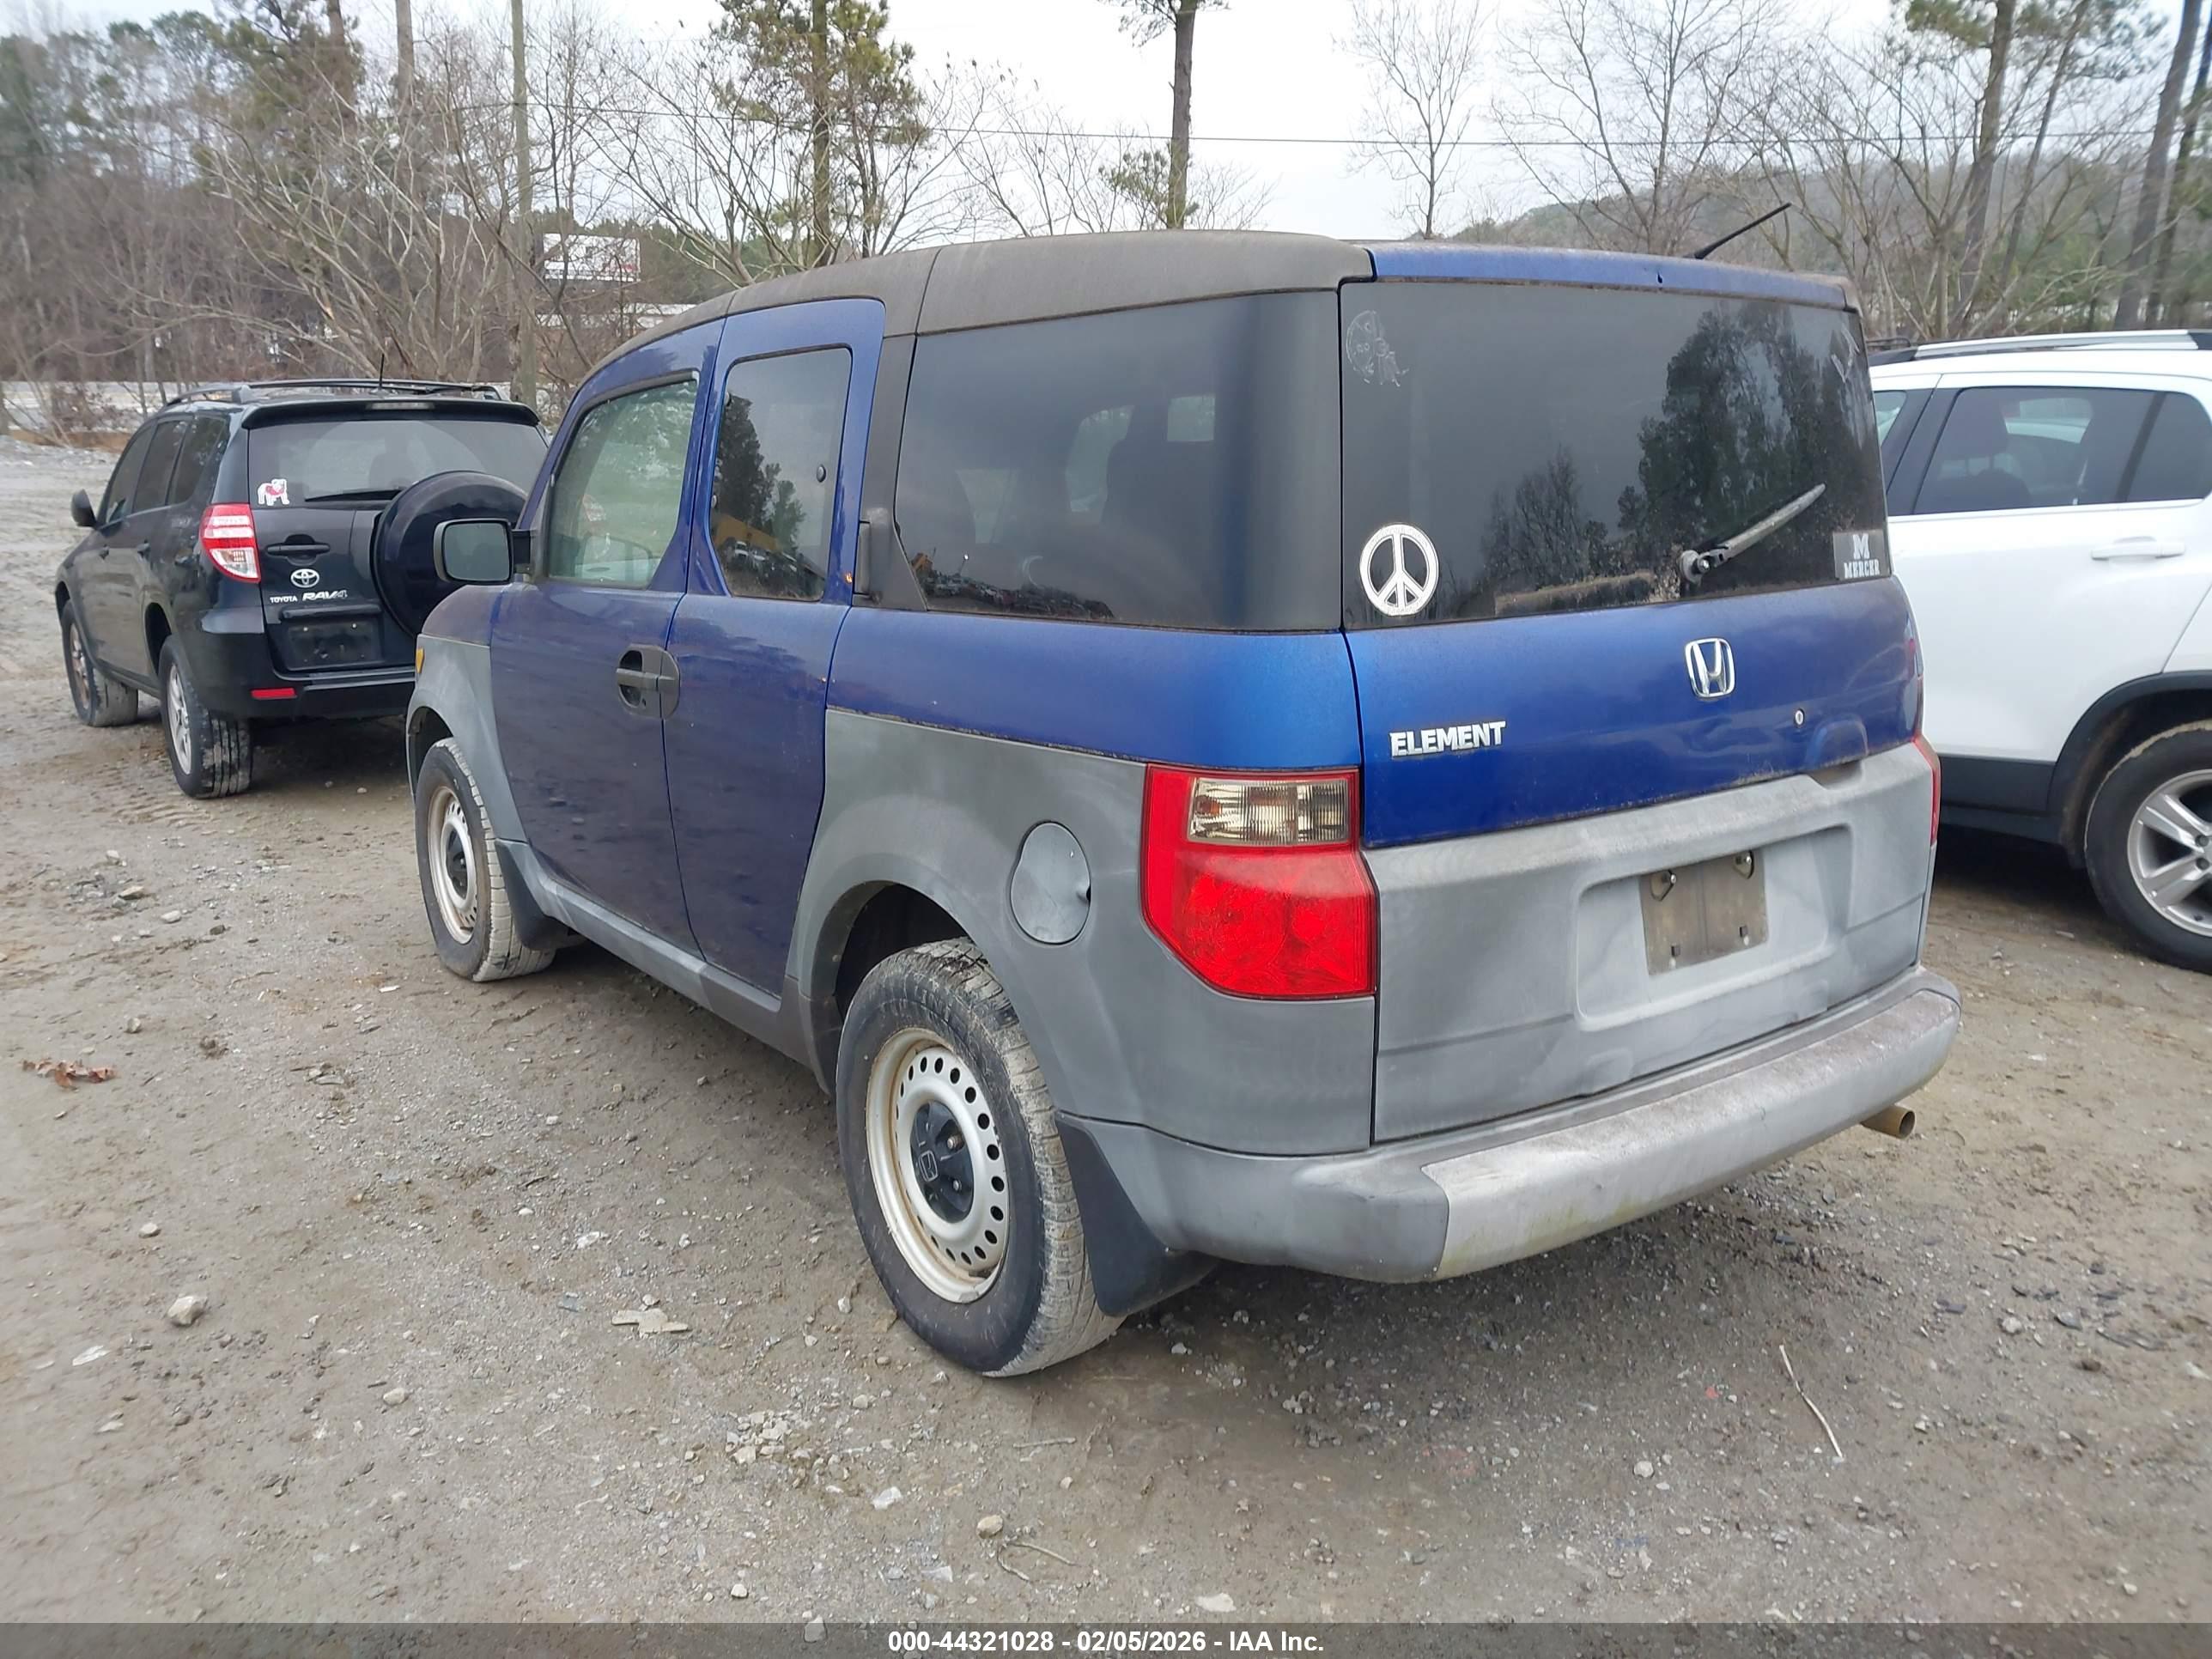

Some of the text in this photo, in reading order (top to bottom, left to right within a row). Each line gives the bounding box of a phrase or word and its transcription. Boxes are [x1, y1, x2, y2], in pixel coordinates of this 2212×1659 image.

[1853, 533, 1870, 559] M
[1844, 559, 1880, 579] MERCER
[302, 590, 348, 601] RAV4
[1389, 721, 1506, 757] ELEMENT
